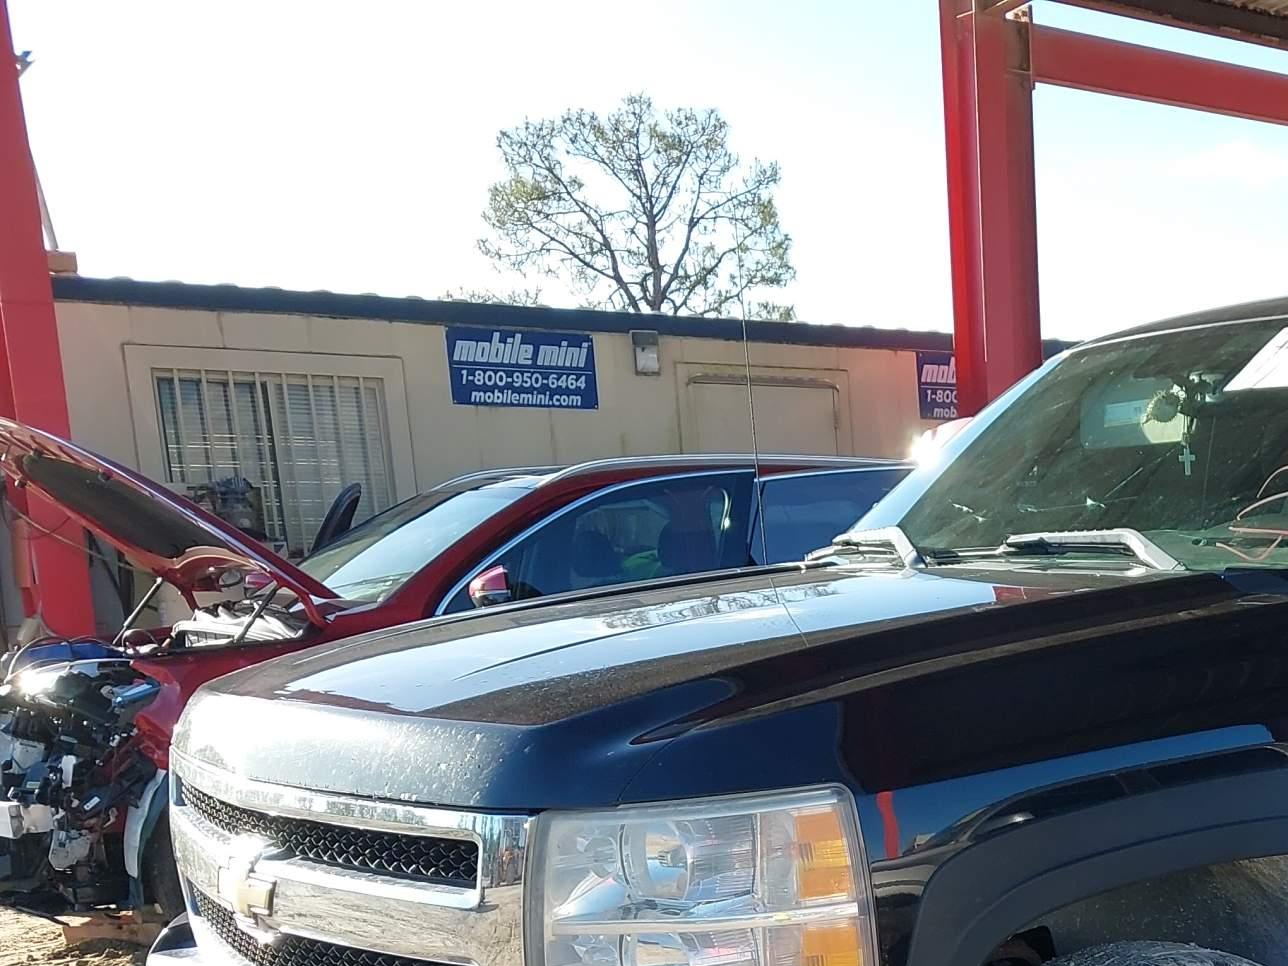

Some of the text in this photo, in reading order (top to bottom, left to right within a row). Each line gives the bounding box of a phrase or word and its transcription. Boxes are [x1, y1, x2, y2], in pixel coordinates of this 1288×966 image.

[452, 331, 589, 368] mobile mini
[460, 369, 586, 390] 1-800-950-6464
[470, 389, 582, 407] mobilemini.com
